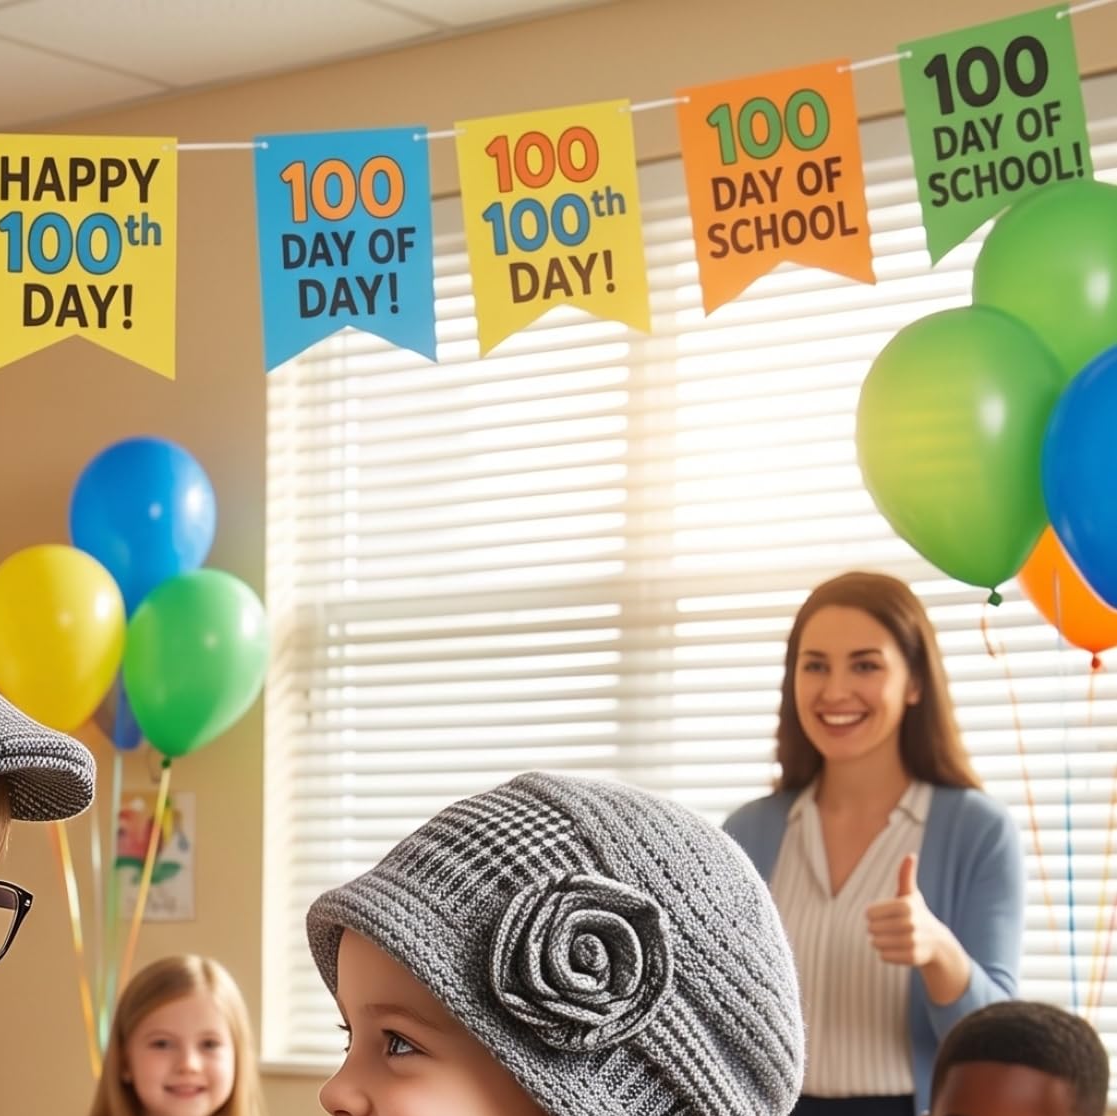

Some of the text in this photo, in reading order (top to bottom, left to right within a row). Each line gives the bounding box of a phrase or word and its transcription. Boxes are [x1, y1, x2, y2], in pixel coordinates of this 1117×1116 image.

[923, 36, 1049, 115] 100
[706, 88, 830, 166] 100
[933, 101, 1063, 161] DAY OF
[0, 156, 160, 203] HAPPY
[279, 155, 405, 223] 100
[485, 126, 599, 193] 100
[711, 156, 843, 212] DAY OF
[928, 142, 1086, 207] SCHOOL!
[282, 227, 416, 270] DAY OF
[482, 186, 626, 256] 100th
[707, 201, 859, 259] SCHOOL
[22, 283, 133, 330] DAY!
[299, 273, 399, 318] DAY!
[508, 250, 616, 304] DAY!
